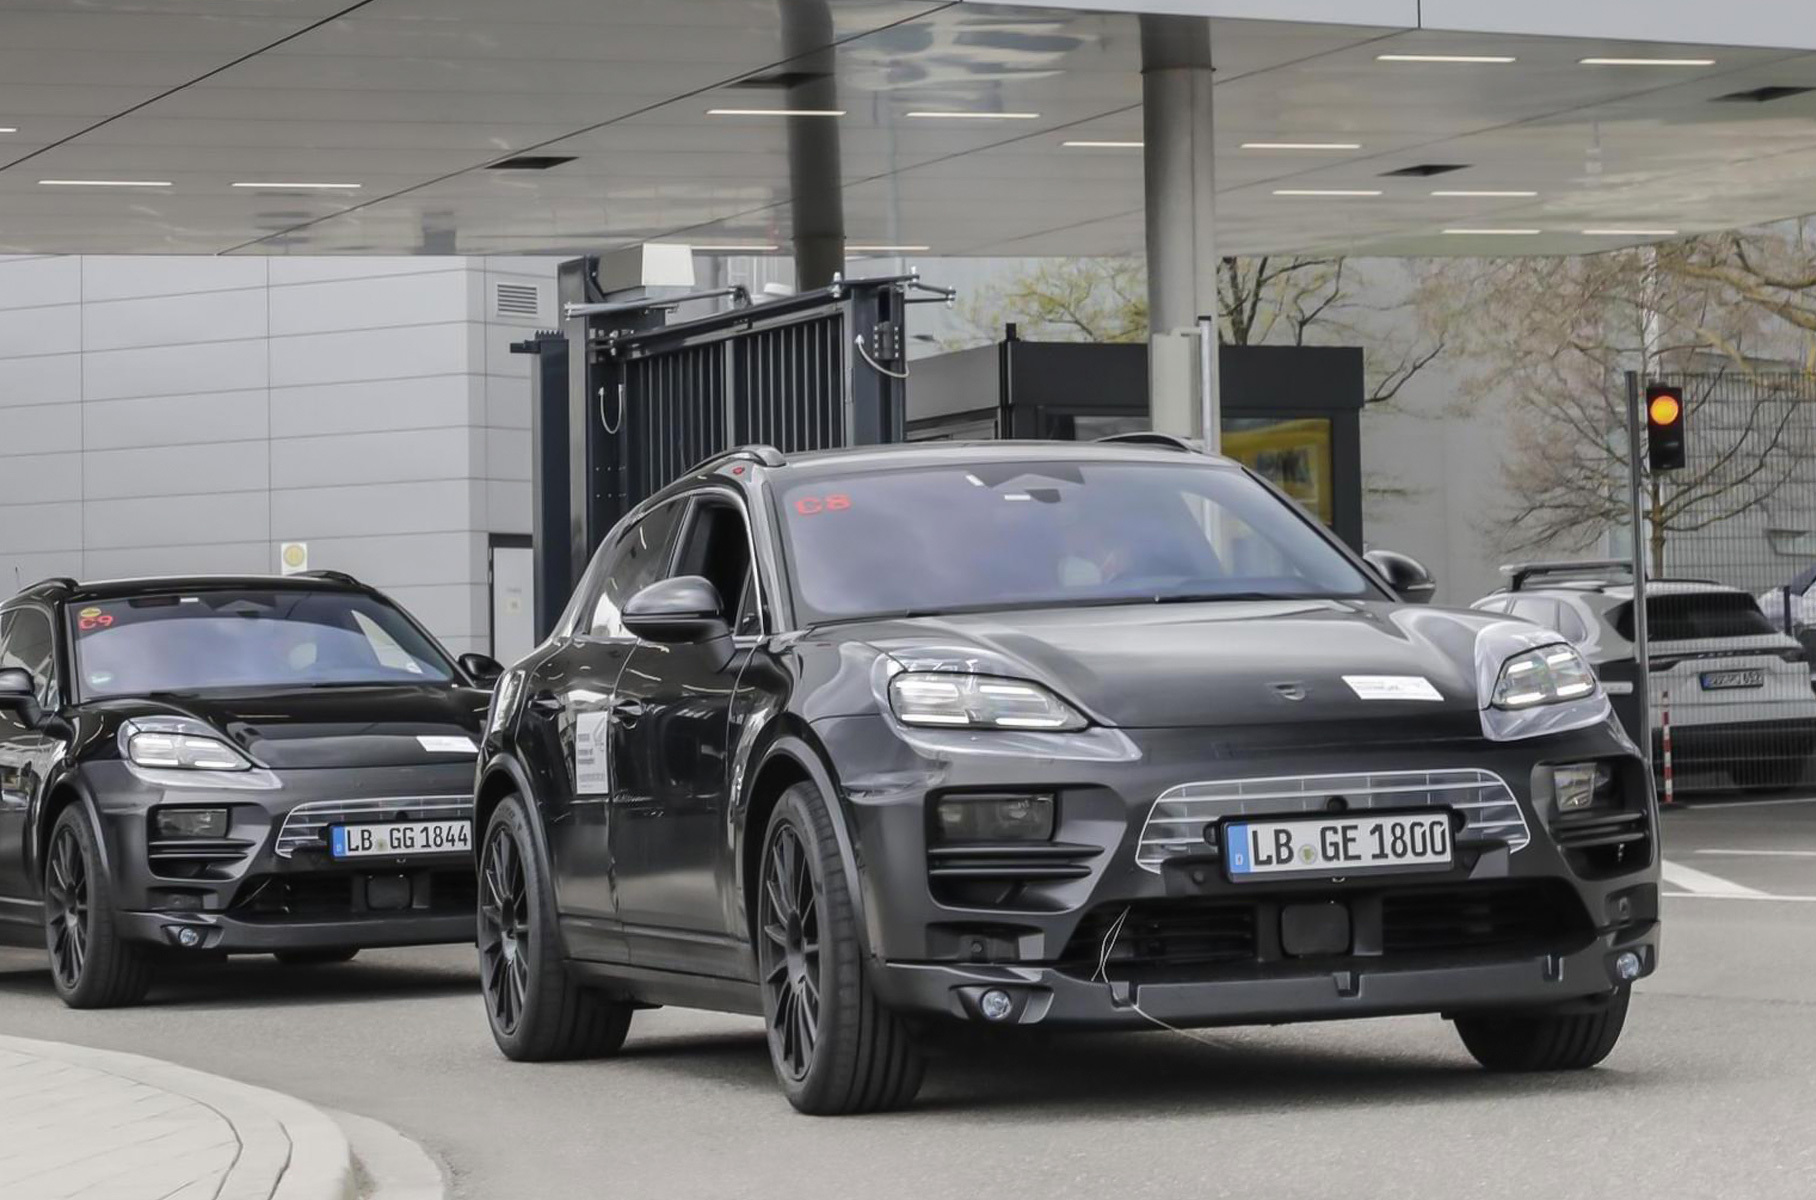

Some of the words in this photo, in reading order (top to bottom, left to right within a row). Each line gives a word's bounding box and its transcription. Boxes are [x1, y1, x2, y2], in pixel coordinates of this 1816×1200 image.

[347, 829, 373, 852] LB
[389, 827, 415, 849] GG
[420, 824, 468, 848] 1844
[1252, 829, 1294, 866] LB
[1320, 825, 1362, 862] GE
[1369, 820, 1447, 860] 1800
